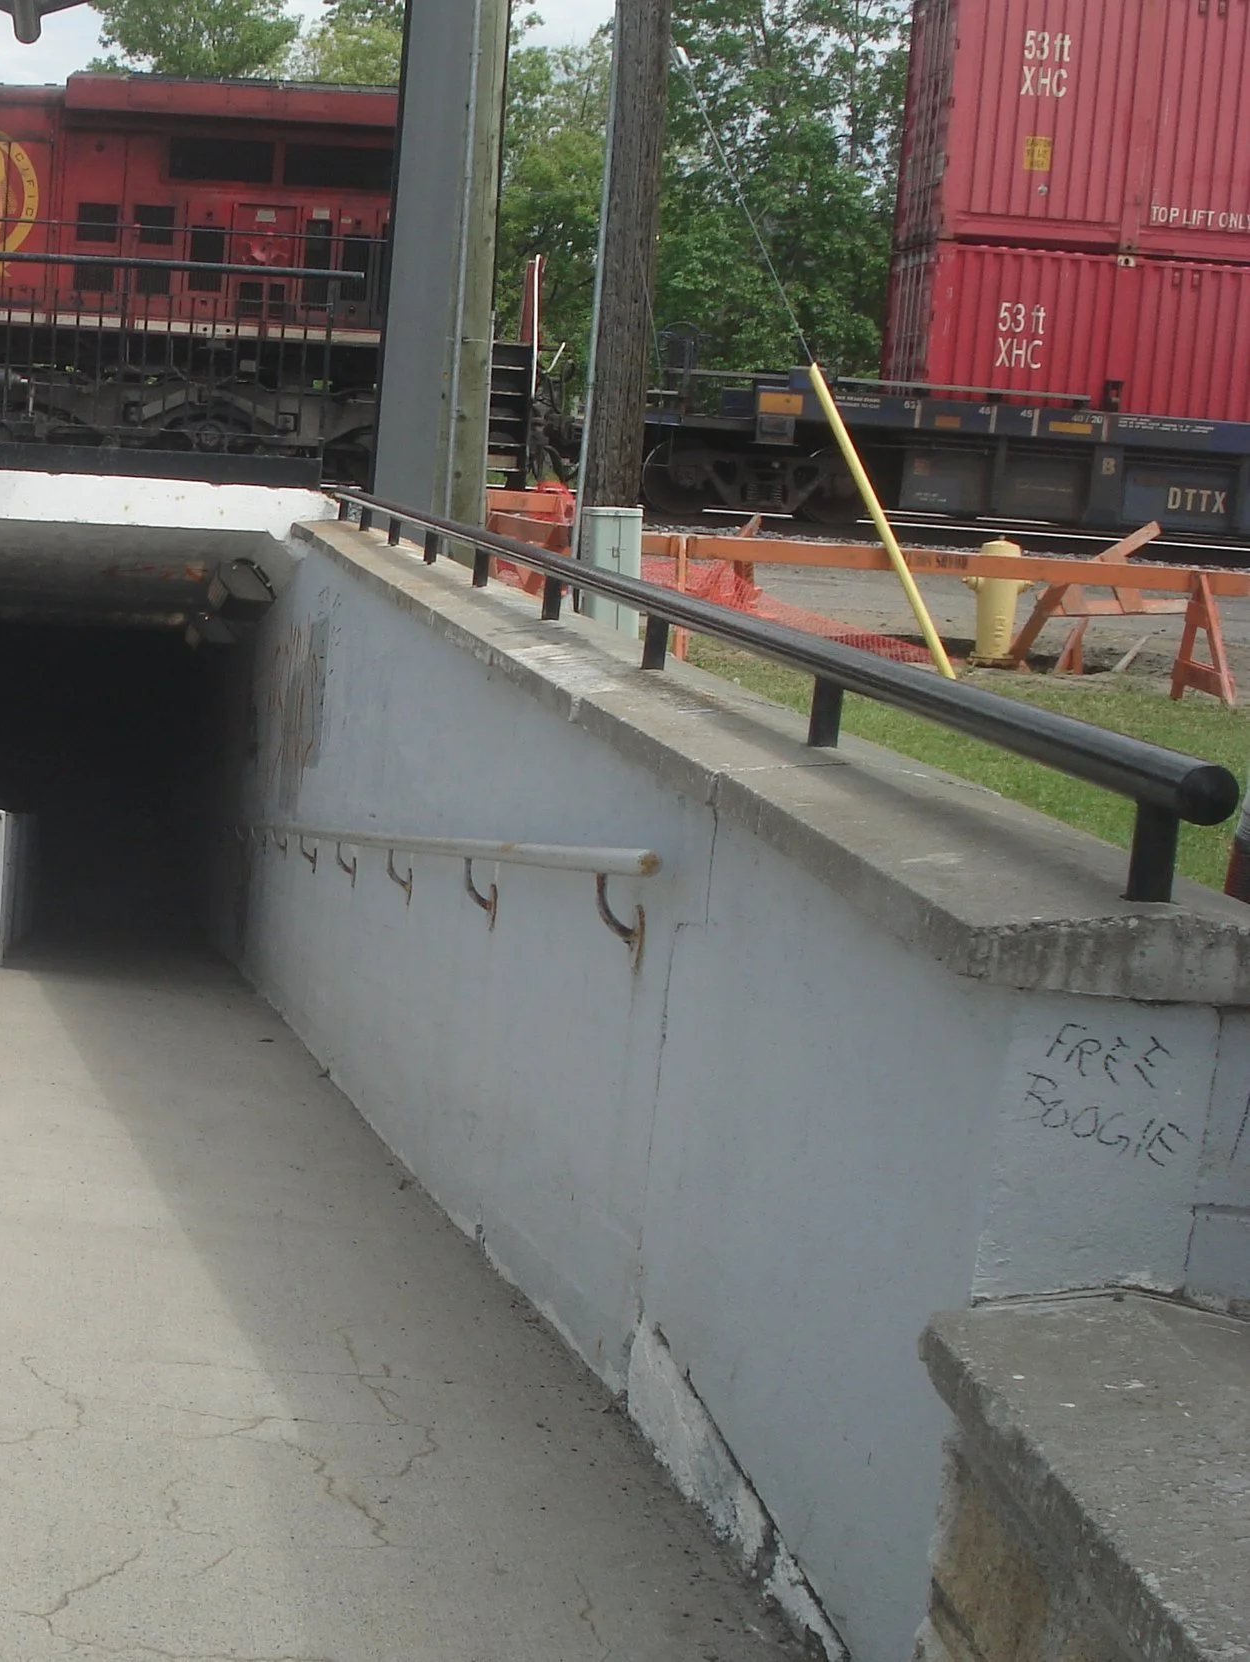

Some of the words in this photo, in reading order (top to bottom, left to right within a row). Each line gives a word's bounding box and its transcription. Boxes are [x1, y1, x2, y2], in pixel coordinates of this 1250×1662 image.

[1024, 30, 1050, 61] 53
[1053, 32, 1072, 63] ft
[1020, 65, 1069, 98] XHC
[1151, 205, 1179, 223] TOP
[1182, 208, 1215, 227] LIFT
[998, 302, 1026, 333] 53
[1031, 303, 1046, 335] ft
[995, 336, 1043, 369] XHC
[1102, 457, 1116, 475] B
[1167, 486, 1227, 515] DTTX
[1046, 1022, 1174, 1090] FREE
